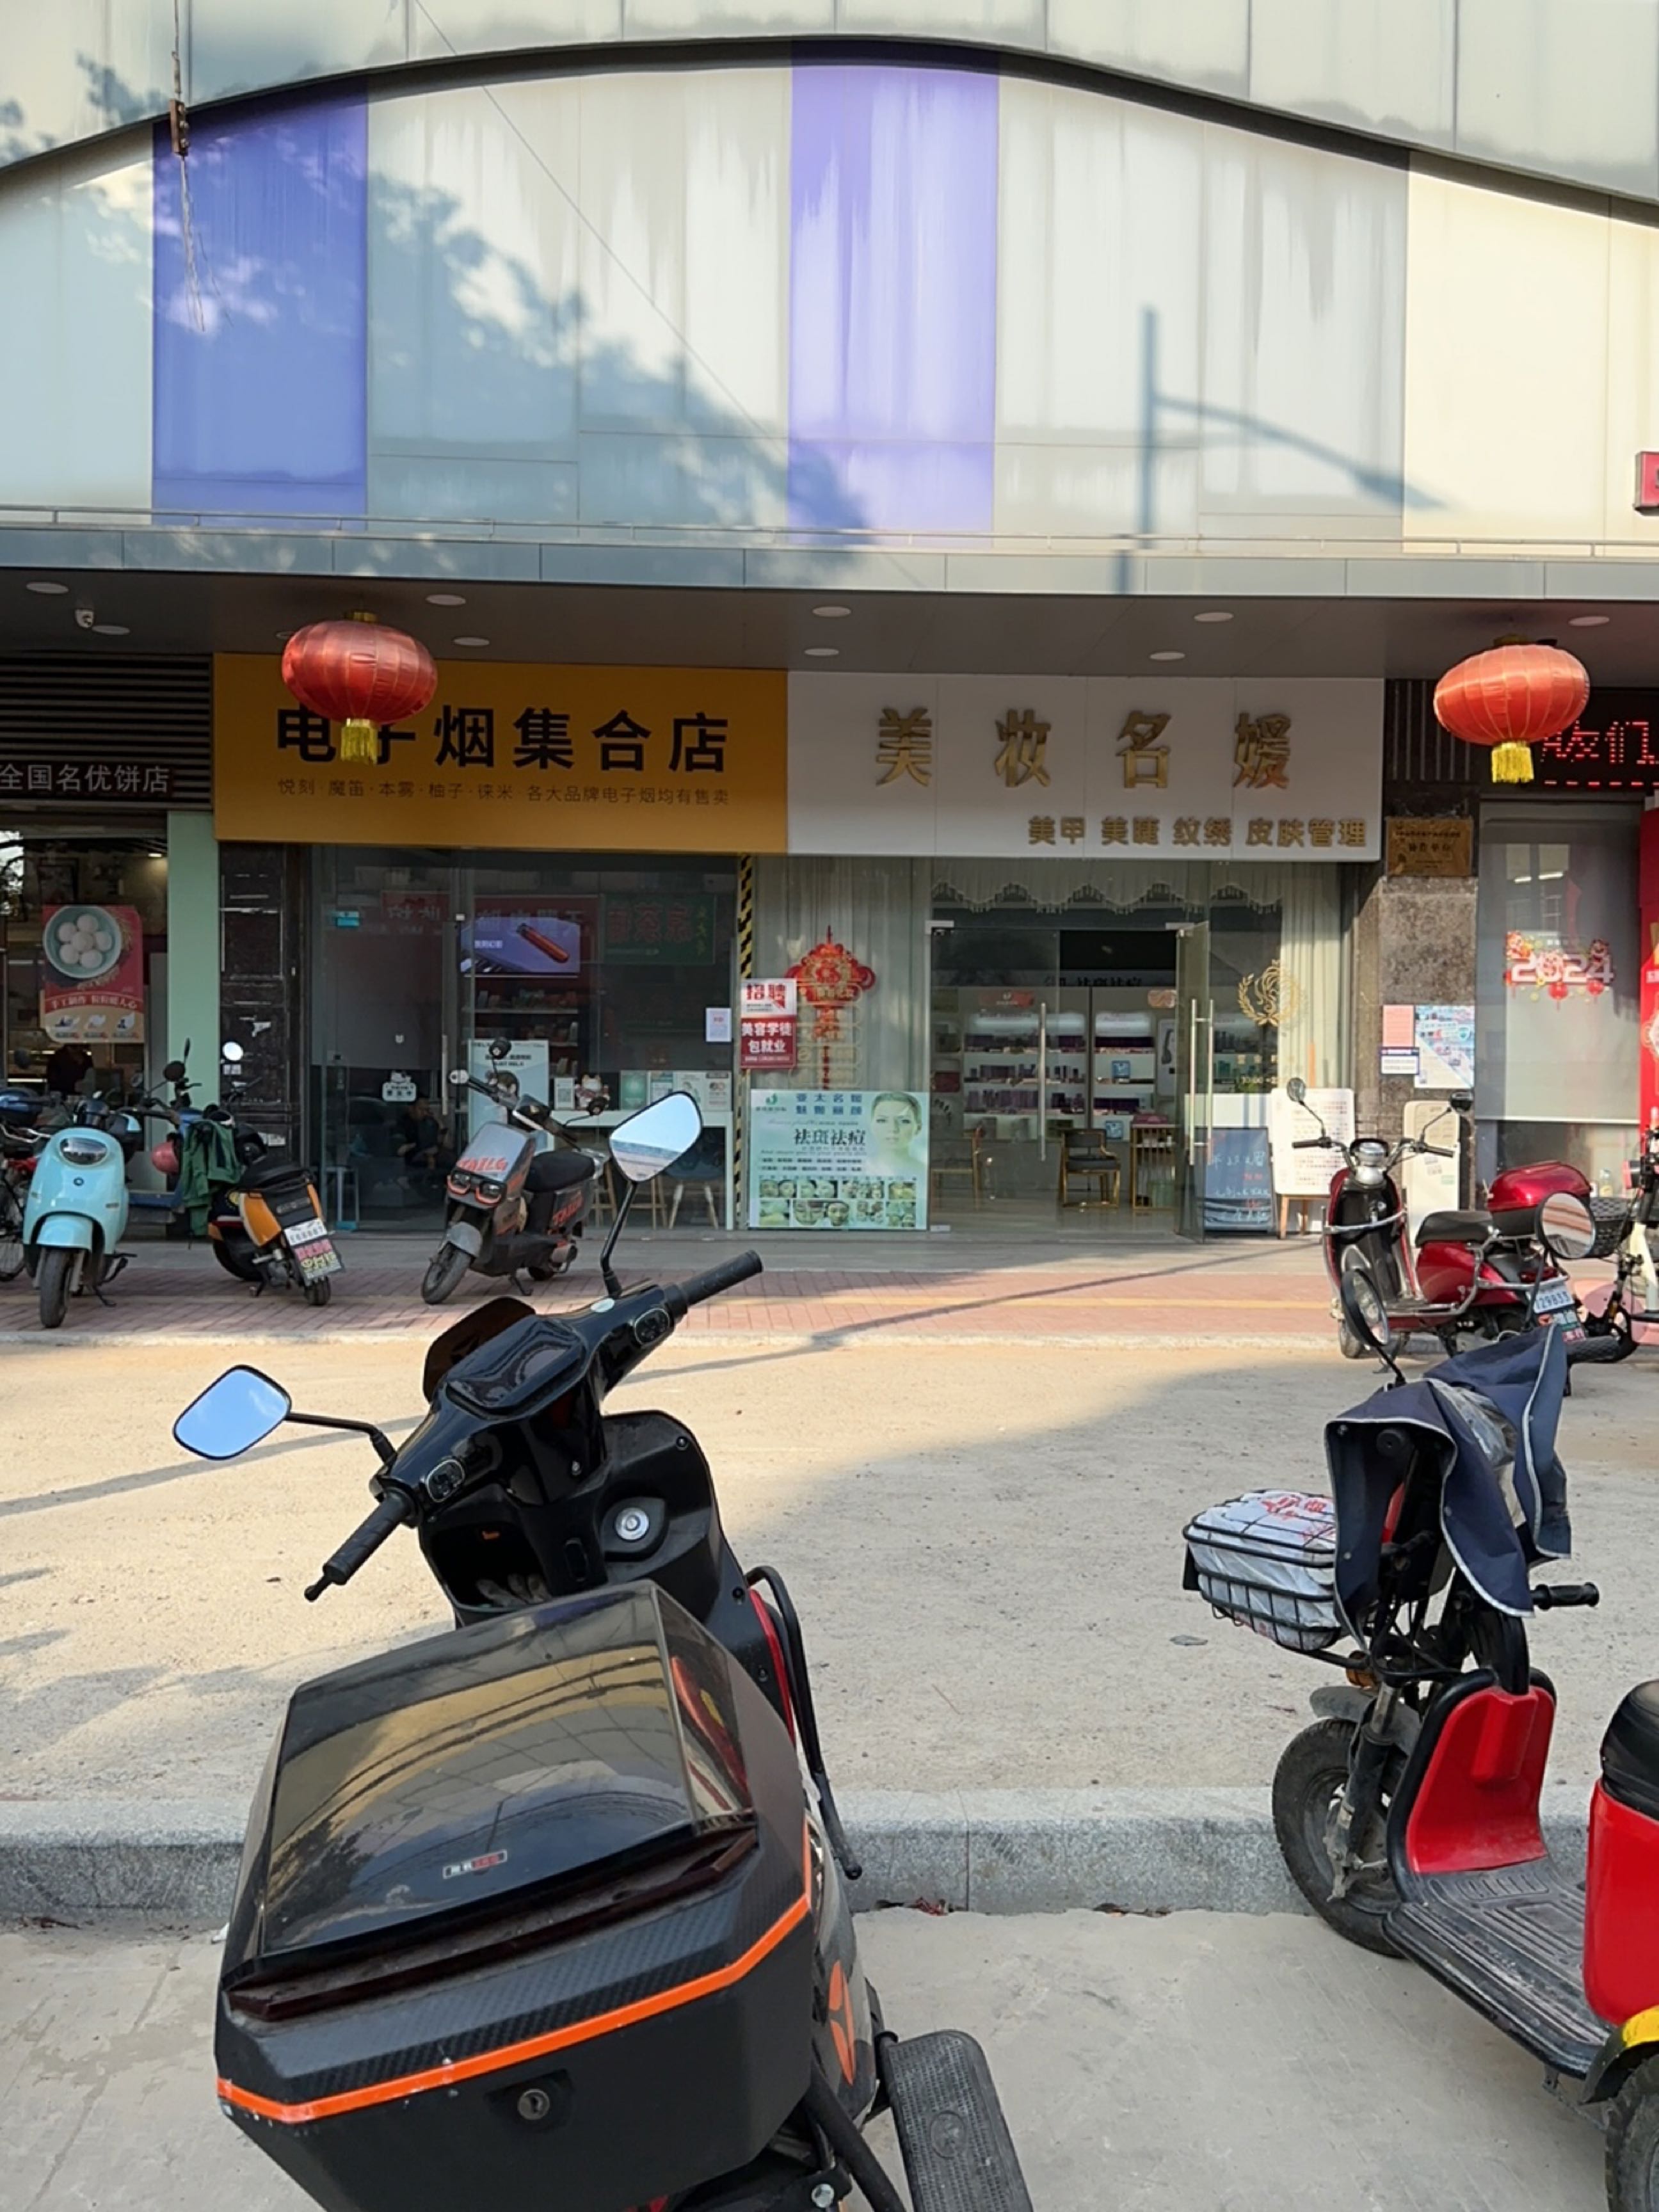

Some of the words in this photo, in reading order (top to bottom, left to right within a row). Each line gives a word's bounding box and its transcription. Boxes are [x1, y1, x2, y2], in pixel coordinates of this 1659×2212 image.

[876, 707, 1292, 790] 美妆名媛
[0, 764, 172, 794] 全国名优饼店
[278, 778, 315, 795] 悦刻
[328, 780, 364, 797] 魔笛
[378, 781, 415, 797] 本雾
[429, 783, 464, 799] 柚子
[527, 785, 728, 806] 各大品牌电子烟均有售卖
[1028, 815, 1086, 846] 美甲
[1102, 816, 1160, 846] 美睫
[1172, 817, 1233, 847] 纹绣
[1246, 818, 1367, 848] 皮肤管理
[1512, 952, 1614, 984] 2024
[746, 982, 786, 1009] 招聘
[748, 1039, 786, 1054] 包就业
[794, 1128, 866, 1146] 祛斑祛痘
